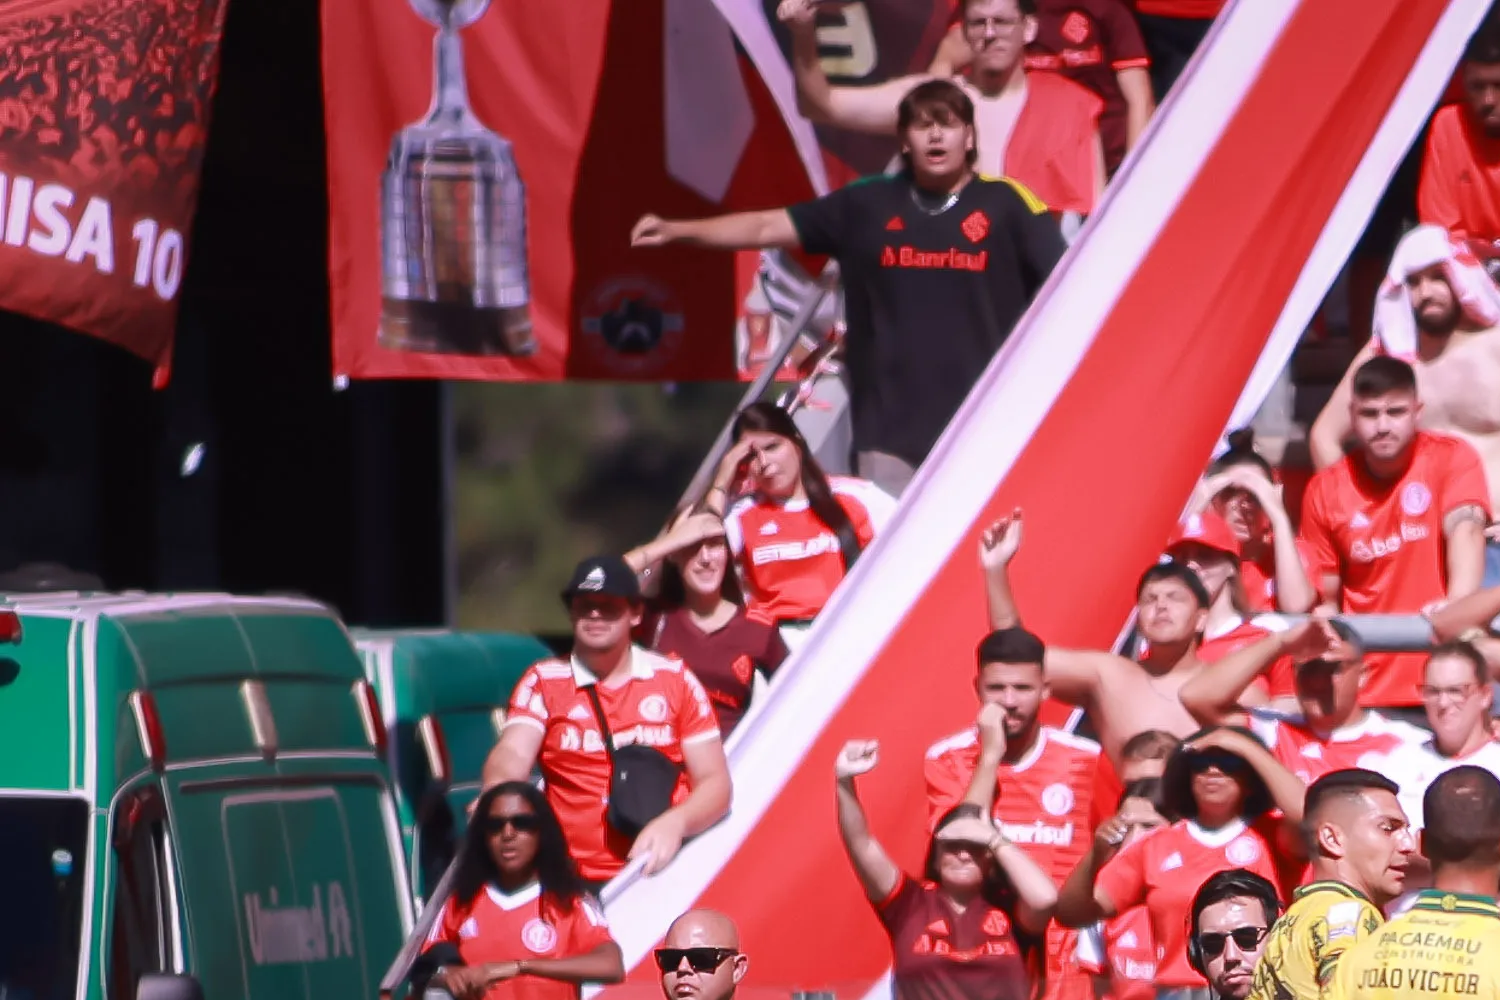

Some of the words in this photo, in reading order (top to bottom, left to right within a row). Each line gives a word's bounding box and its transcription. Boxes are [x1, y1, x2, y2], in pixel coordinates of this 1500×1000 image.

[0, 172, 115, 275] ISA
[132, 218, 184, 301] 10
[899, 247, 989, 272] Banrisul
[997, 819, 1074, 848] nrisul
[1378, 931, 1482, 955] PACAEMBU
[1358, 961, 1403, 990] JOÃO
[1408, 969, 1480, 996] VICTOR
